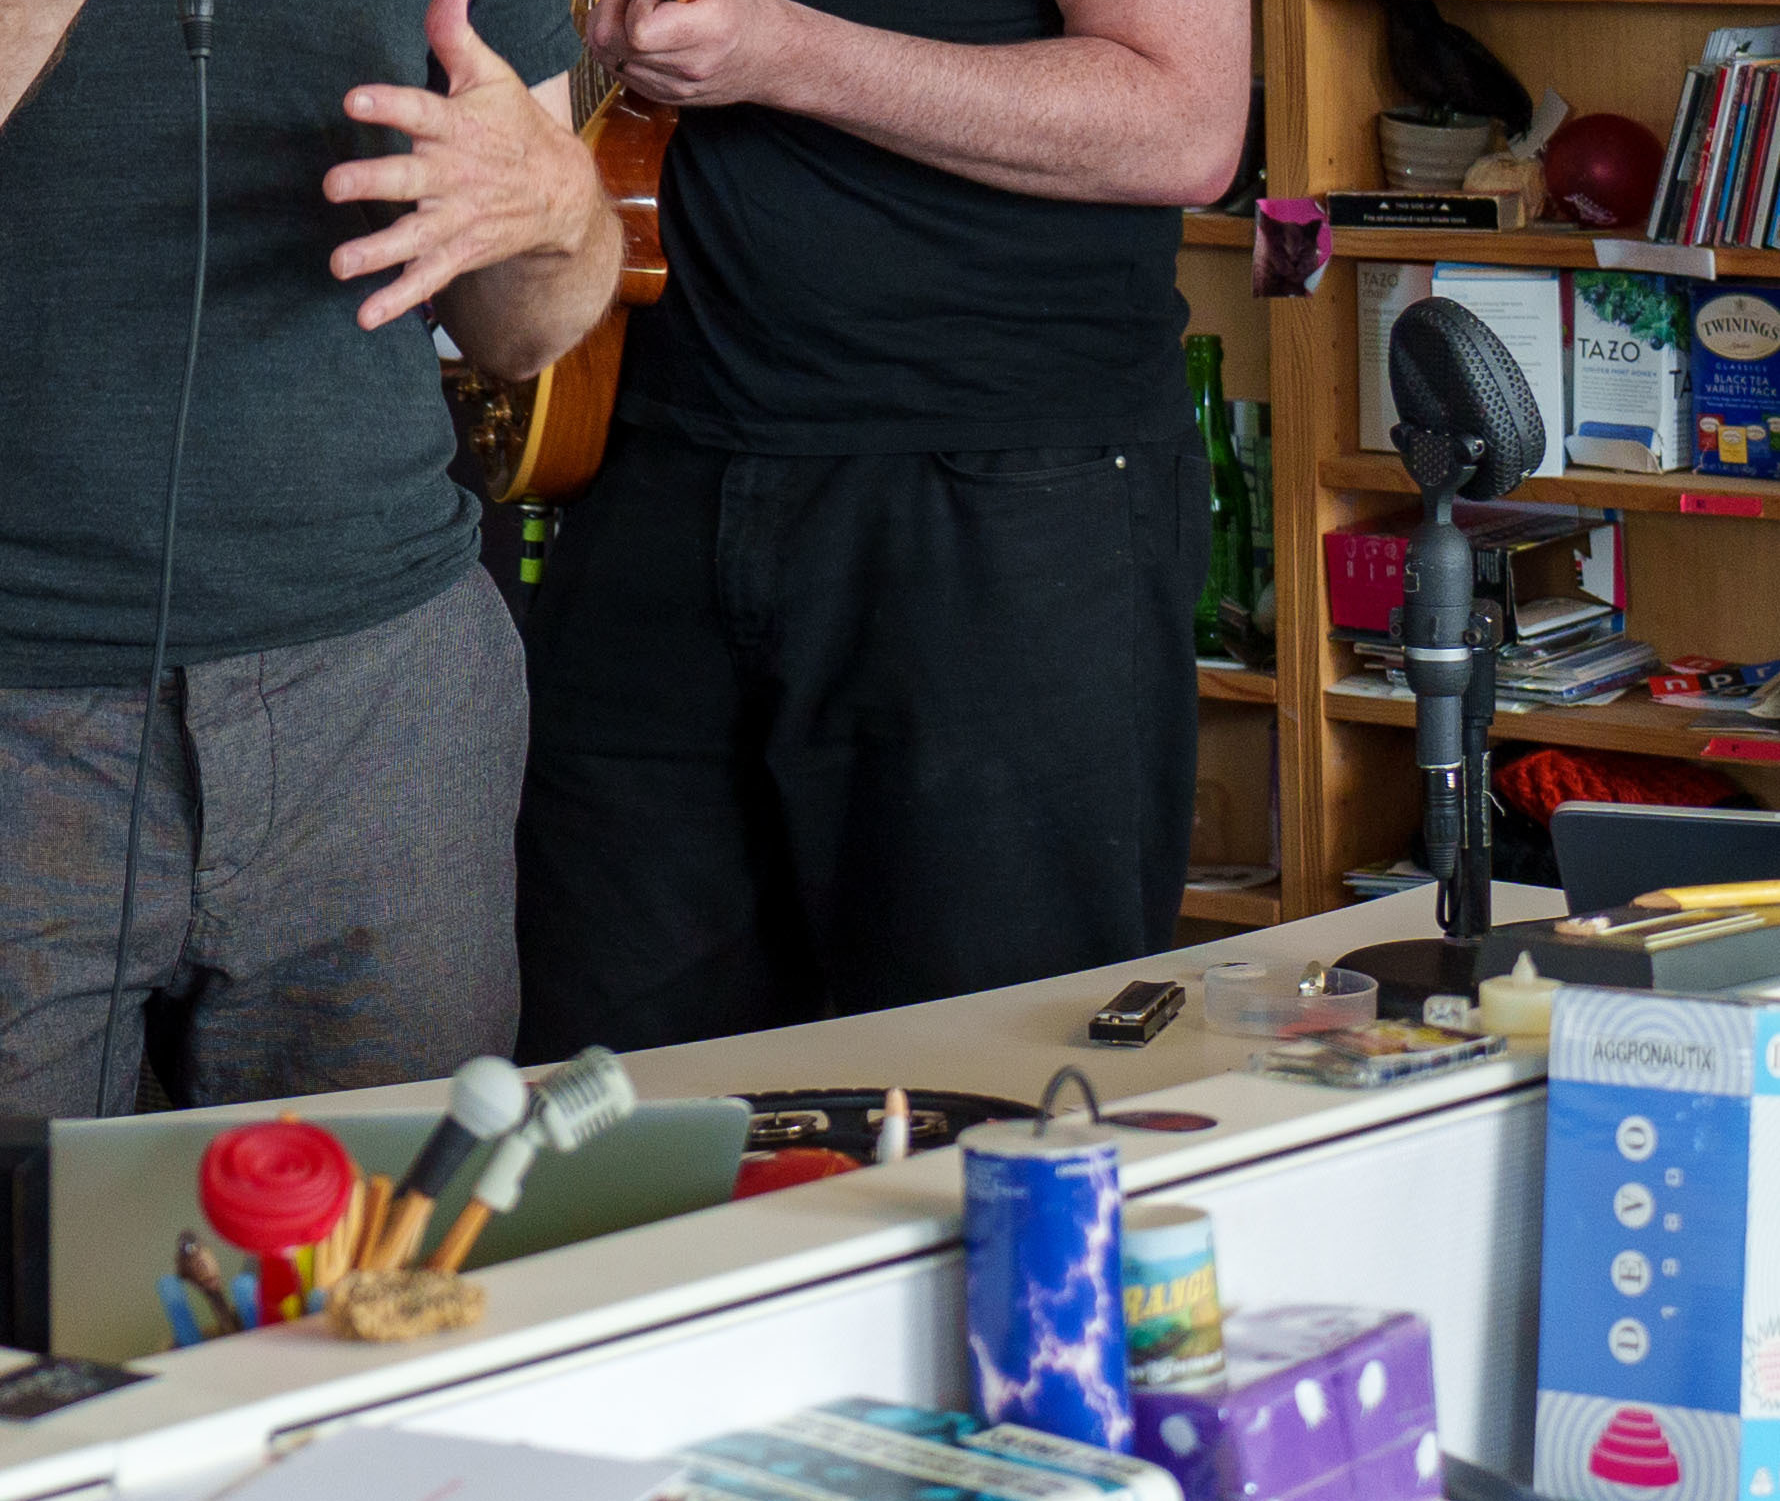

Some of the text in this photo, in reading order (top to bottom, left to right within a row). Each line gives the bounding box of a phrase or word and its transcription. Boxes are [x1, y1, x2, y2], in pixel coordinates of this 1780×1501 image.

[1701, 317, 1780, 341] TWININGS
[1578, 337, 1641, 363] TAZO
[1704, 383, 1778, 397] VARIETY PACK
[1713, 373, 1770, 386] BLACK TEA
[1591, 1039, 1717, 1071] AGGRONAUTIX
